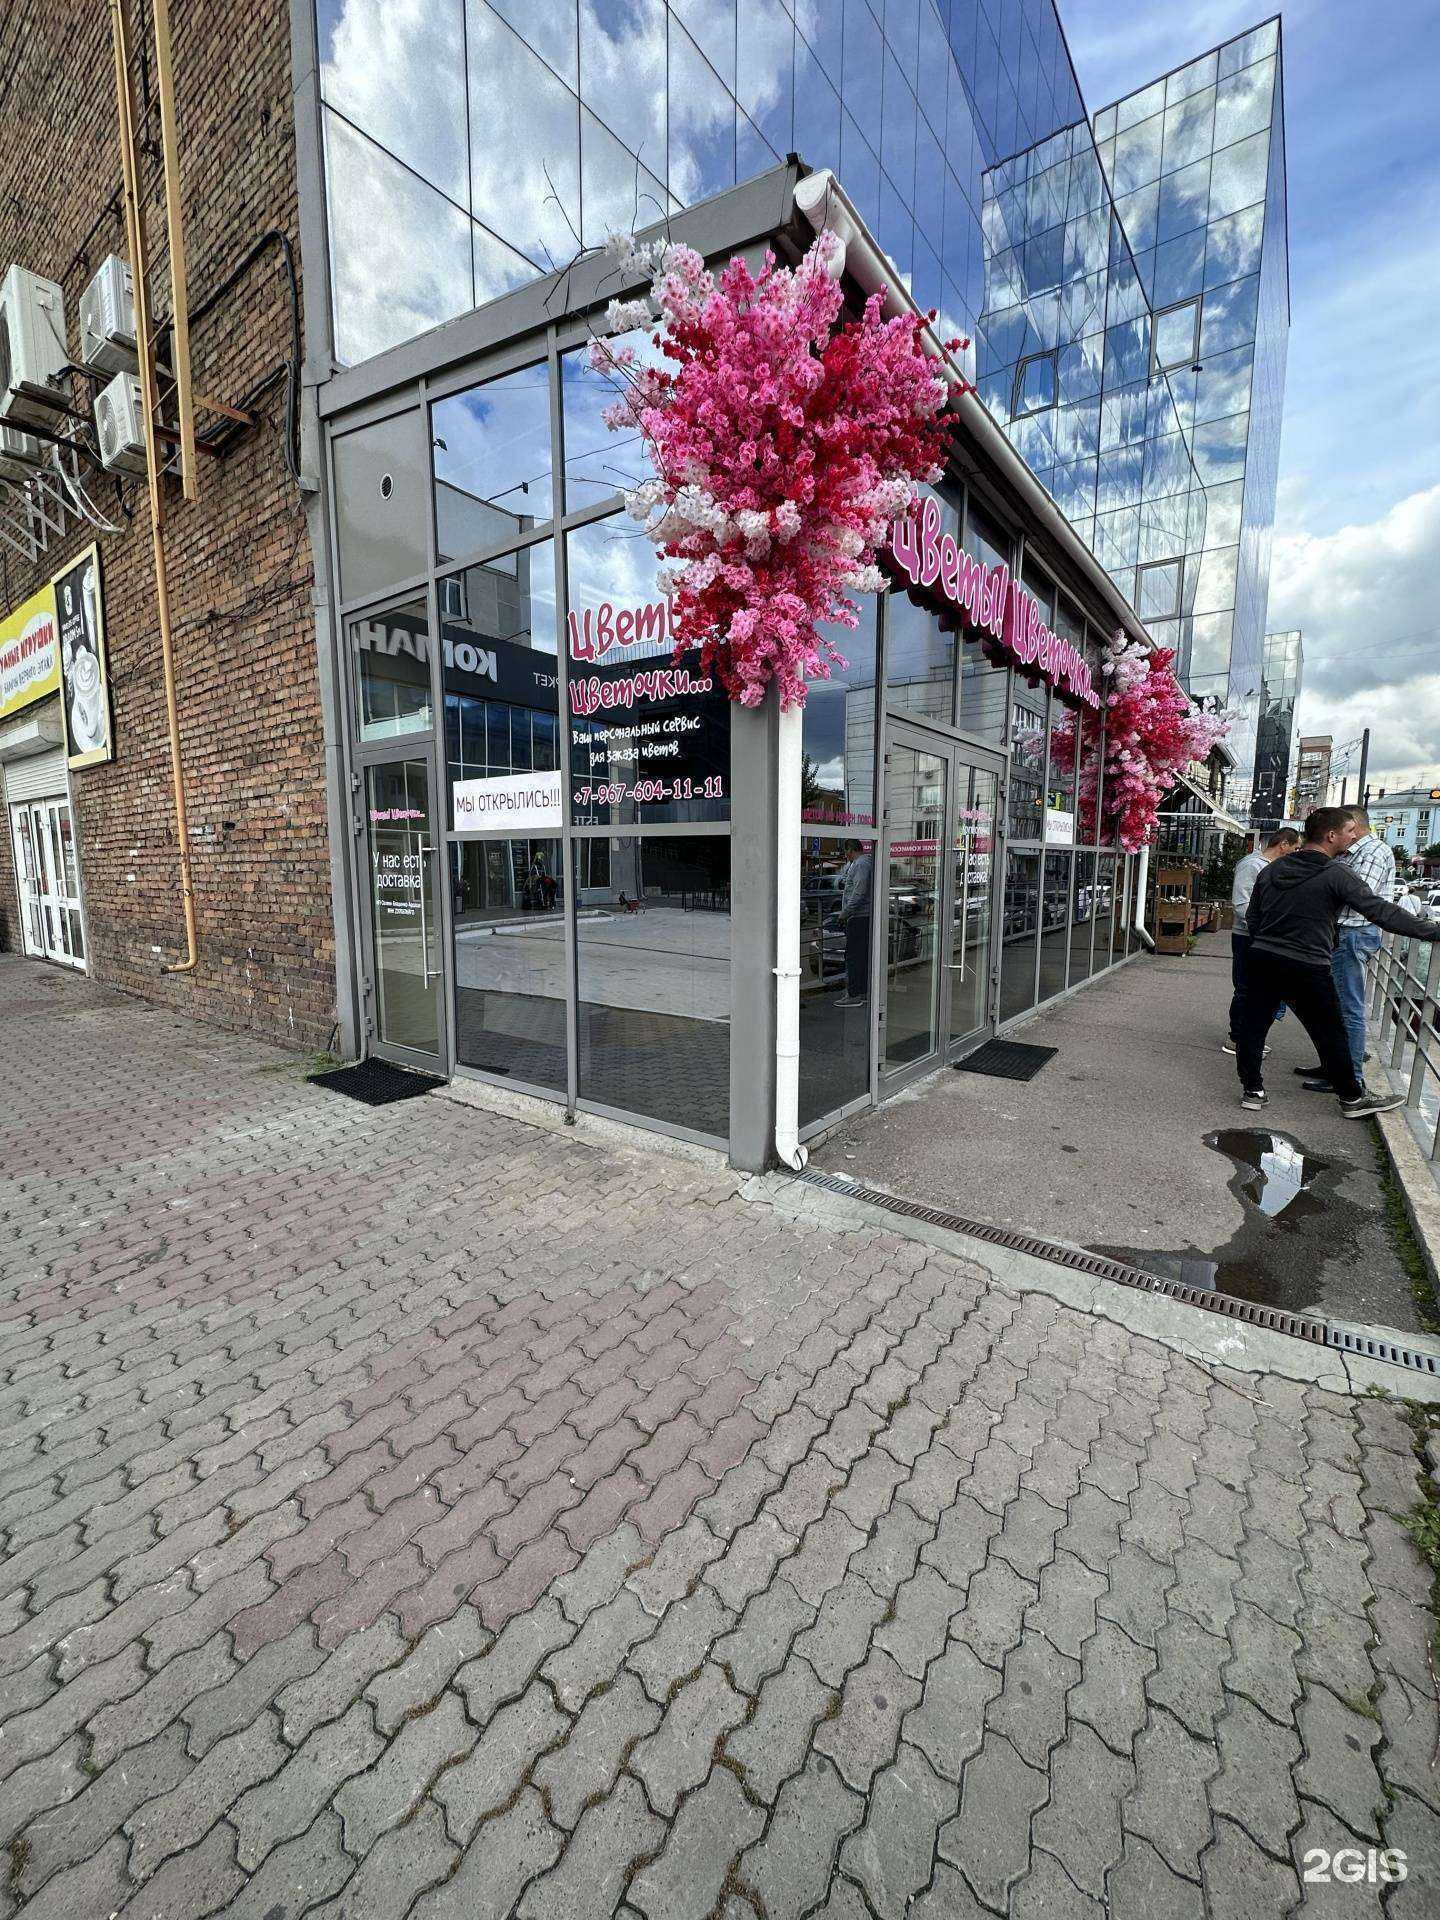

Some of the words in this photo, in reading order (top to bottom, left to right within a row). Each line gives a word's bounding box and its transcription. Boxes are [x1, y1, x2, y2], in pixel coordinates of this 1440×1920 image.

[893, 480, 1009, 639] Цветы!
[1012, 578, 1100, 710] Цветочки...
[569, 669, 713, 715] Цветочки...
[594, 720, 660, 744] персональный
[589, 750, 605, 766] для
[606, 746, 639, 764] заказа
[641, 741, 679, 758] цветов
[456, 796, 475, 812] МЫ
[479, 788, 561, 812] ОТКРЫЛИСЬ!!!
[574, 776, 723, 805] +7-967-604-11-11
[372, 851, 380, 867] У
[382, 854, 400, 868] нас
